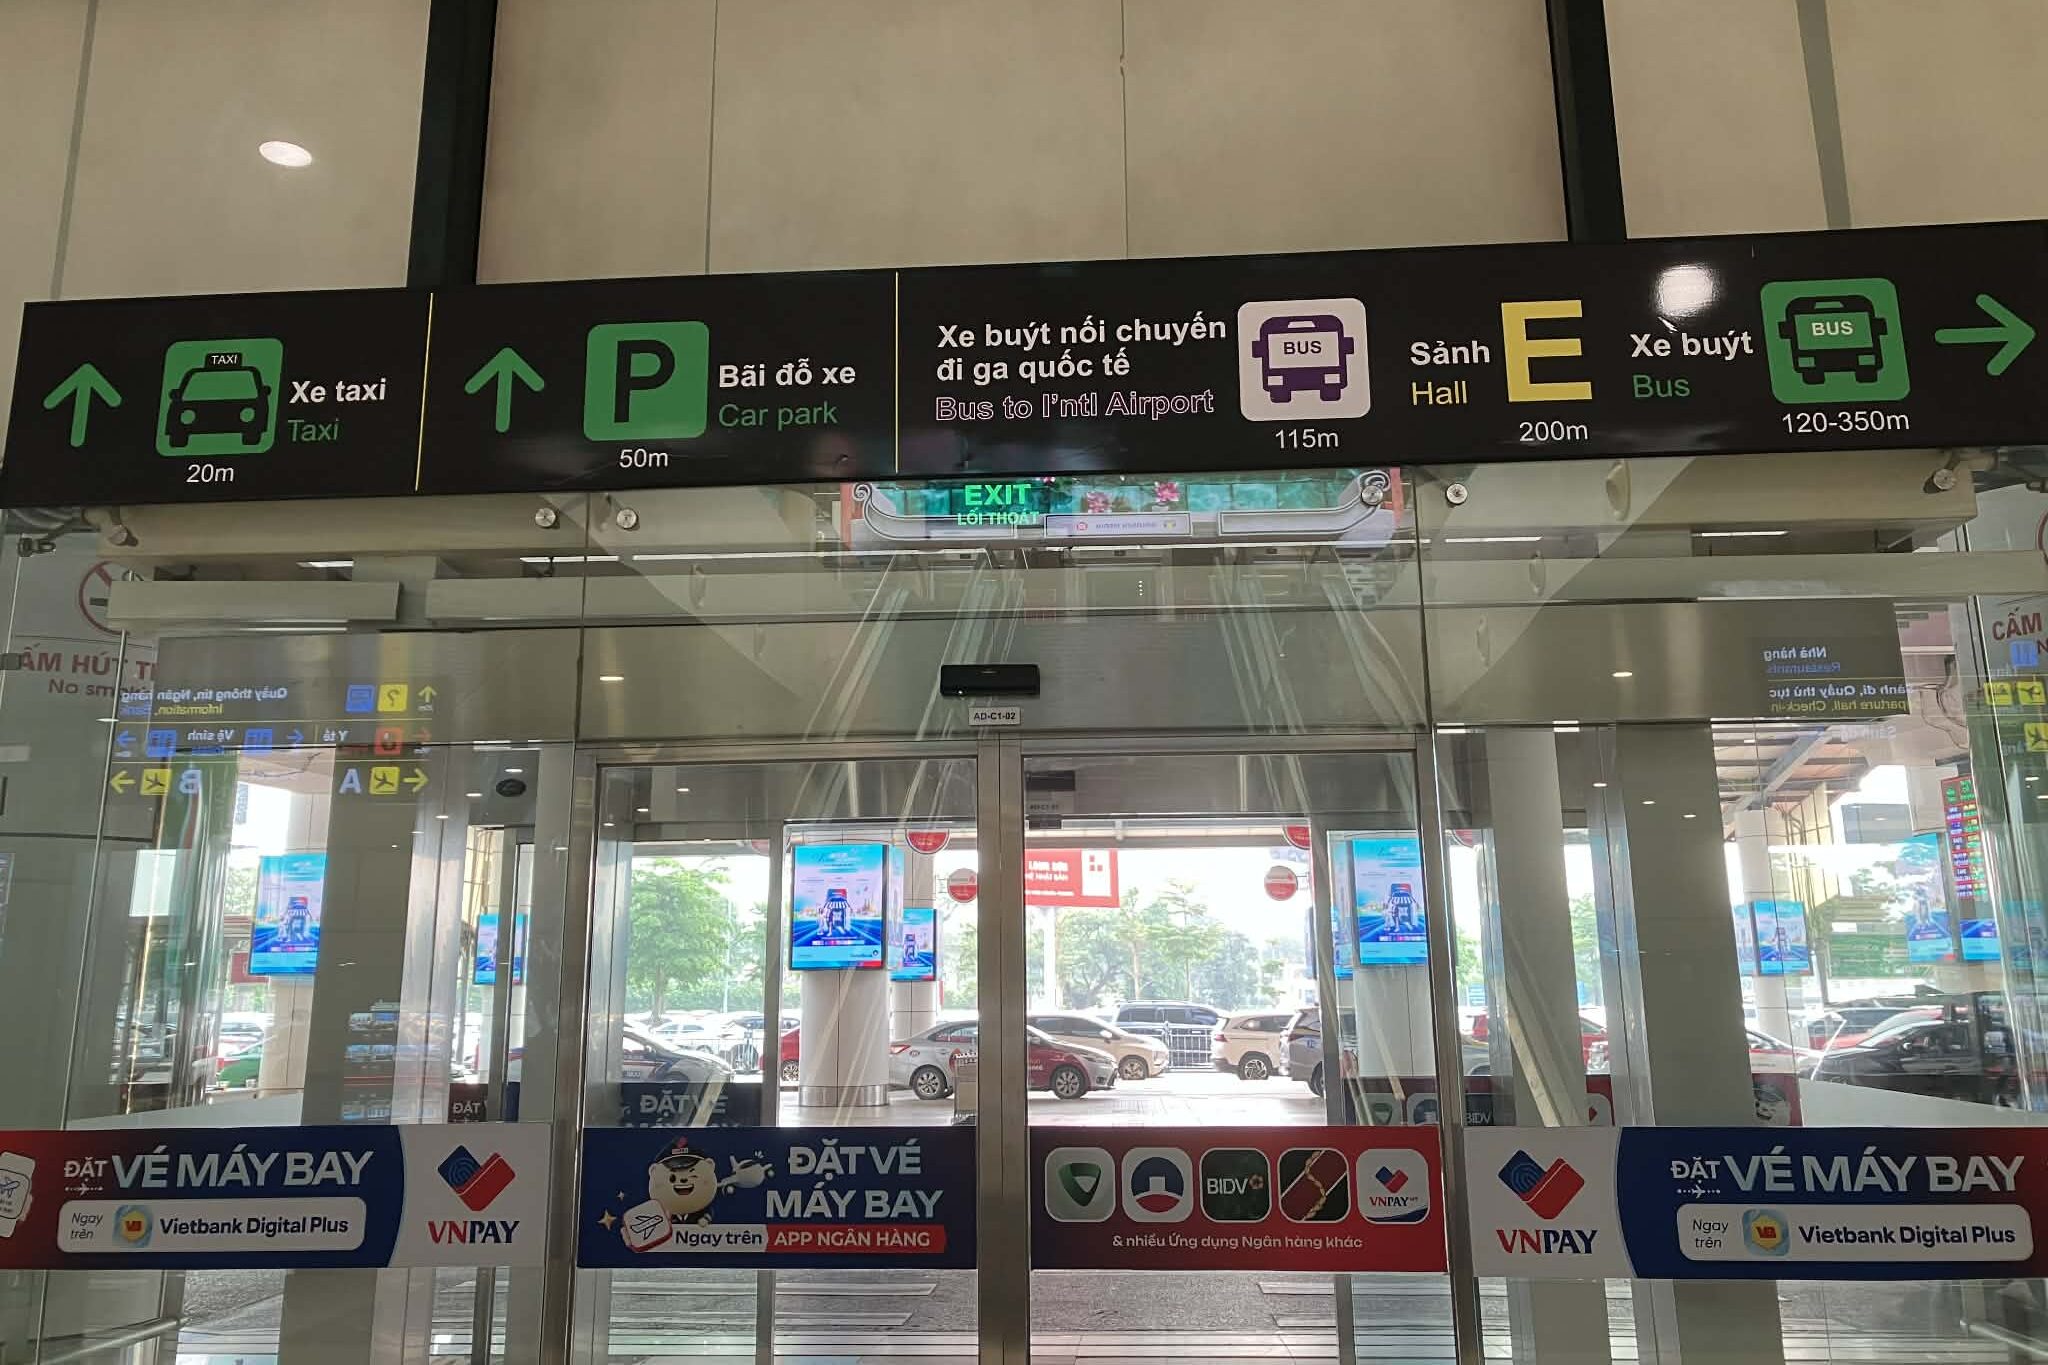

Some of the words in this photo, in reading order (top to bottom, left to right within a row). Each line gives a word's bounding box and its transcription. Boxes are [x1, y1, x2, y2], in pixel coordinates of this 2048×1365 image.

[937, 324, 975, 349] Xe
[985, 317, 1051, 352] buýt
[1060, 313, 1106, 343] nối
[1115, 310, 1228, 349] chuyến
[1811, 321, 1853, 337] BUS
[1283, 339, 1322, 356] BUS
[1410, 339, 1490, 366] Sảnh
[1501, 300, 1592, 403] E
[1631, 334, 1672, 358] Xe
[1682, 329, 1754, 362] buýt
[211, 353, 239, 365] TAXI
[937, 358, 964, 382] đi
[973, 362, 1008, 387] ga
[1018, 350, 1093, 387] quốc
[1103, 350, 1131, 376] tế
[719, 364, 766, 389] Bãi
[775, 356, 813, 386] đỗ
[822, 366, 857, 385] xe
[288, 380, 327, 405] Xe
[335, 379, 387, 403] taxi
[1411, 381, 1468, 406] Hall
[1633, 374, 1691, 399] Bus
[719, 402, 768, 428] Car
[776, 401, 838, 429] park
[936, 396, 993, 421] Bus
[1003, 395, 1032, 419] to
[1106, 388, 1214, 422] Airport
[288, 418, 341, 443] Taxi
[1518, 420, 1589, 442] 200m
[1781, 410, 1910, 434] 120-350m
[1275, 428, 1340, 449] 115m
[619, 447, 669, 469] 50m
[186, 463, 235, 484] 20m
[964, 484, 1031, 506] EXIT
[957, 509, 984, 526] LỐI
[989, 508, 1040, 526] THOÁT
[1992, 606, 2043, 641] CẤM
[20, 643, 63, 672] ẤM
[48, 679, 79, 694] No
[973, 712, 1016, 721] AD-C1-02
[64, 1157, 109, 1182] ĐẶT
[111, 1145, 170, 1190] VÉ
[176, 1144, 279, 1190] MÁY
[284, 1150, 374, 1187] BAY
[788, 1137, 865, 1180] ĐẶT
[866, 1138, 921, 1176] VÉ
[1670, 1157, 1721, 1184] ĐẶT
[1722, 1146, 1794, 1192] VÉ
[1805, 1145, 1925, 1193] MÁY
[1928, 1154, 2025, 1193] BAY
[1207, 1178, 1248, 1196] BIDV
[765, 1182, 859, 1219] MÁY
[865, 1189, 943, 1219] BAY
[1369, 1196, 1409, 1207] VNPAY
[72, 1212, 104, 1227] Ngay
[160, 1217, 243, 1236] Vietbank
[247, 1216, 306, 1238] Digital
[309, 1216, 349, 1234] Plus
[1692, 1218, 1729, 1235] Ngay
[70, 1228, 94, 1241] trên
[428, 1219, 520, 1245] VNPAY
[675, 1231, 723, 1250] Ngay
[726, 1229, 762, 1246] trên
[774, 1231, 812, 1246] APP
[817, 1227, 872, 1247] NGÂN
[877, 1226, 930, 1247] HÀNG
[1113, 1235, 1123, 1247] &
[1126, 1233, 1166, 1248] nhiều
[1169, 1231, 1198, 1251] Ứng
[1201, 1234, 1239, 1252] dụng
[1242, 1234, 1282, 1251] Ngân
[1285, 1233, 1323, 1251] hàng
[1326, 1233, 1363, 1248] khác
[1496, 1228, 1598, 1255] VNPAY
[1694, 1234, 1722, 1250] trên
[1799, 1225, 1896, 1244] Vietbank
[1899, 1224, 1968, 1248] Digital
[1971, 1224, 2016, 1244] Plus
